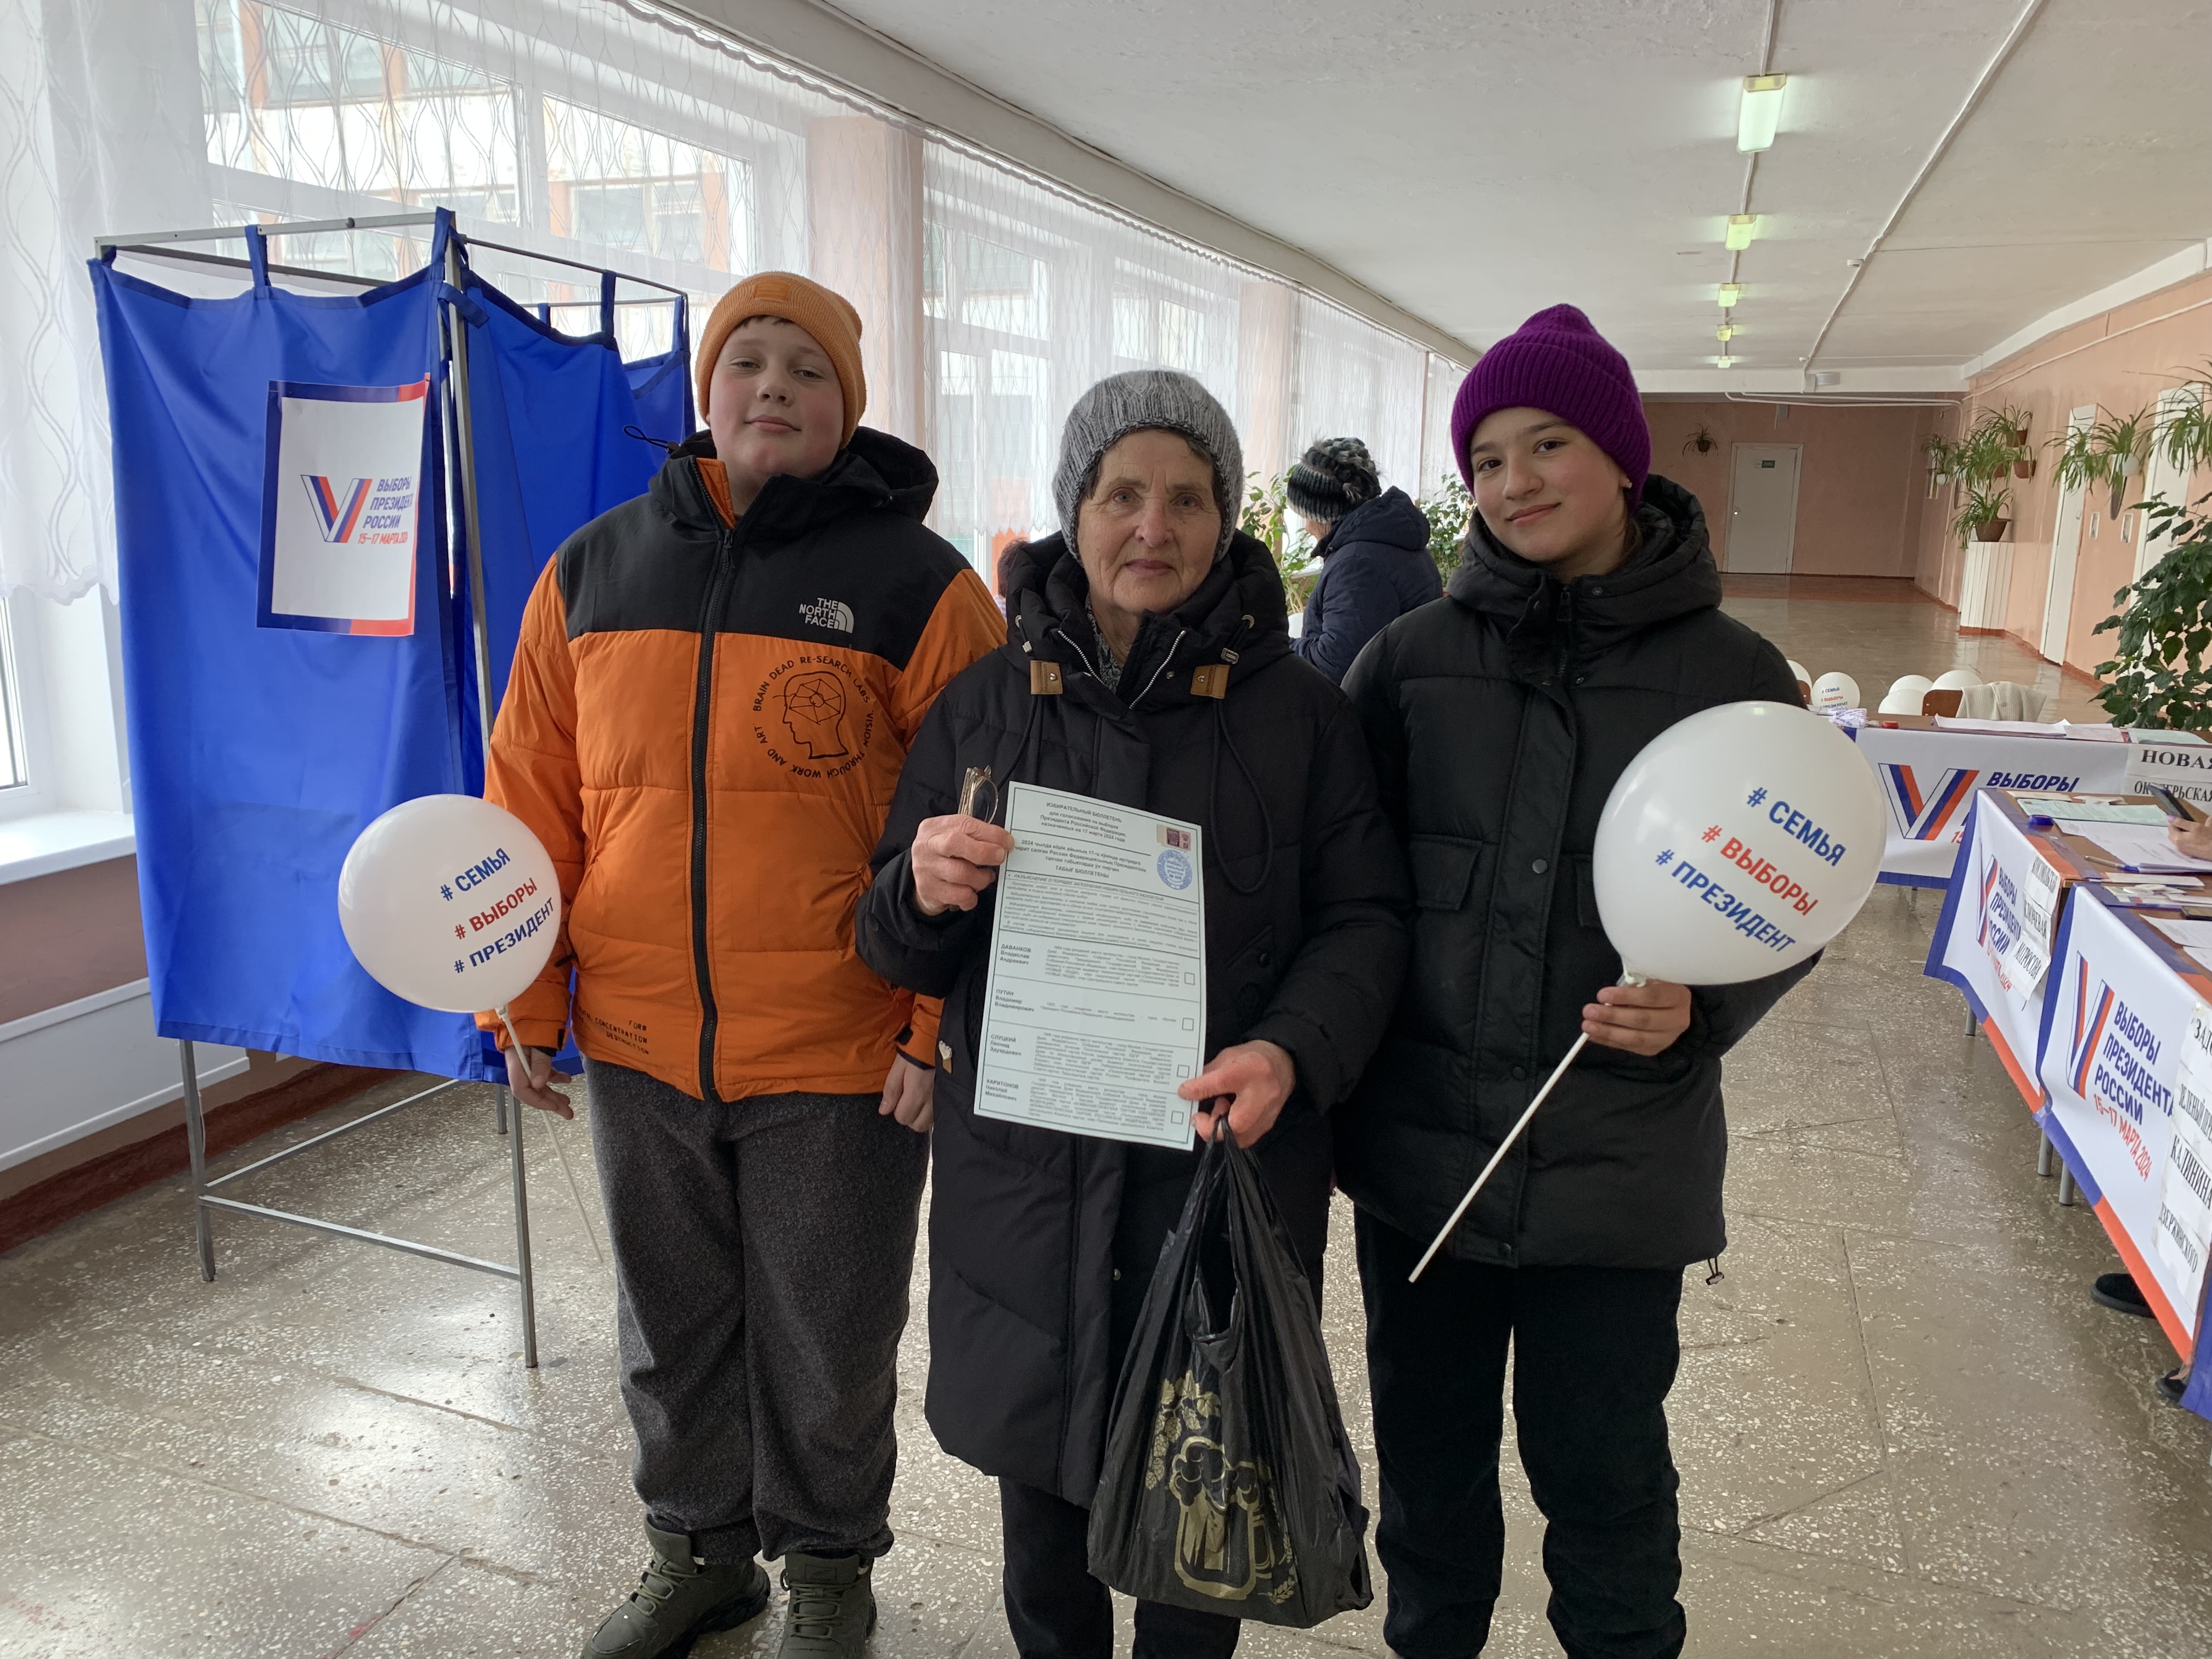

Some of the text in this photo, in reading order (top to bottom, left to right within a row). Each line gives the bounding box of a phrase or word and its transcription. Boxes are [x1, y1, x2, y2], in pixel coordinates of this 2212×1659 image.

[376, 476, 411, 492] ВЫБОРЫ
[363, 515, 401, 529] РОССИИ
[379, 532, 399, 545] МАРТА
[799, 603, 837, 619] NORTH
[805, 614, 835, 629] FACE
[817, 597, 839, 610] THE
[753, 656, 871, 712] BRAIN DEAD RE-SEARCH LABS
[754, 713, 874, 778] VISION THROUGH WORK AND ART
[1987, 771, 2080, 792] ВЫБОРЫ
[1046, 802, 1122, 823] ИЗБИРАТЕЛЬНЫЙ БЮЛЛЕТЕНЬ
[1768, 800, 1847, 867] СЕМЬЯ
[455, 847, 511, 891] СЕМЬЯ
[1720, 837, 1819, 916] ВЫБОРЫ
[469, 878, 538, 932] ВЫБОРЫ
[1671, 860, 1797, 952] ПРЕЗИДЕНТ
[469, 897, 555, 967] ПРЕЗИДЕНТ
[1001, 944, 1031, 952] ДАВАНКОВ
[1988, 917, 2010, 955] ОССИИ
[2114, 1000, 2161, 1065] ВЫБОРЫ
[2095, 1063, 2144, 1126] РОССИИ
[2119, 1115, 2142, 1160] МАРТА
[2135, 1146, 2152, 1182] 2024
